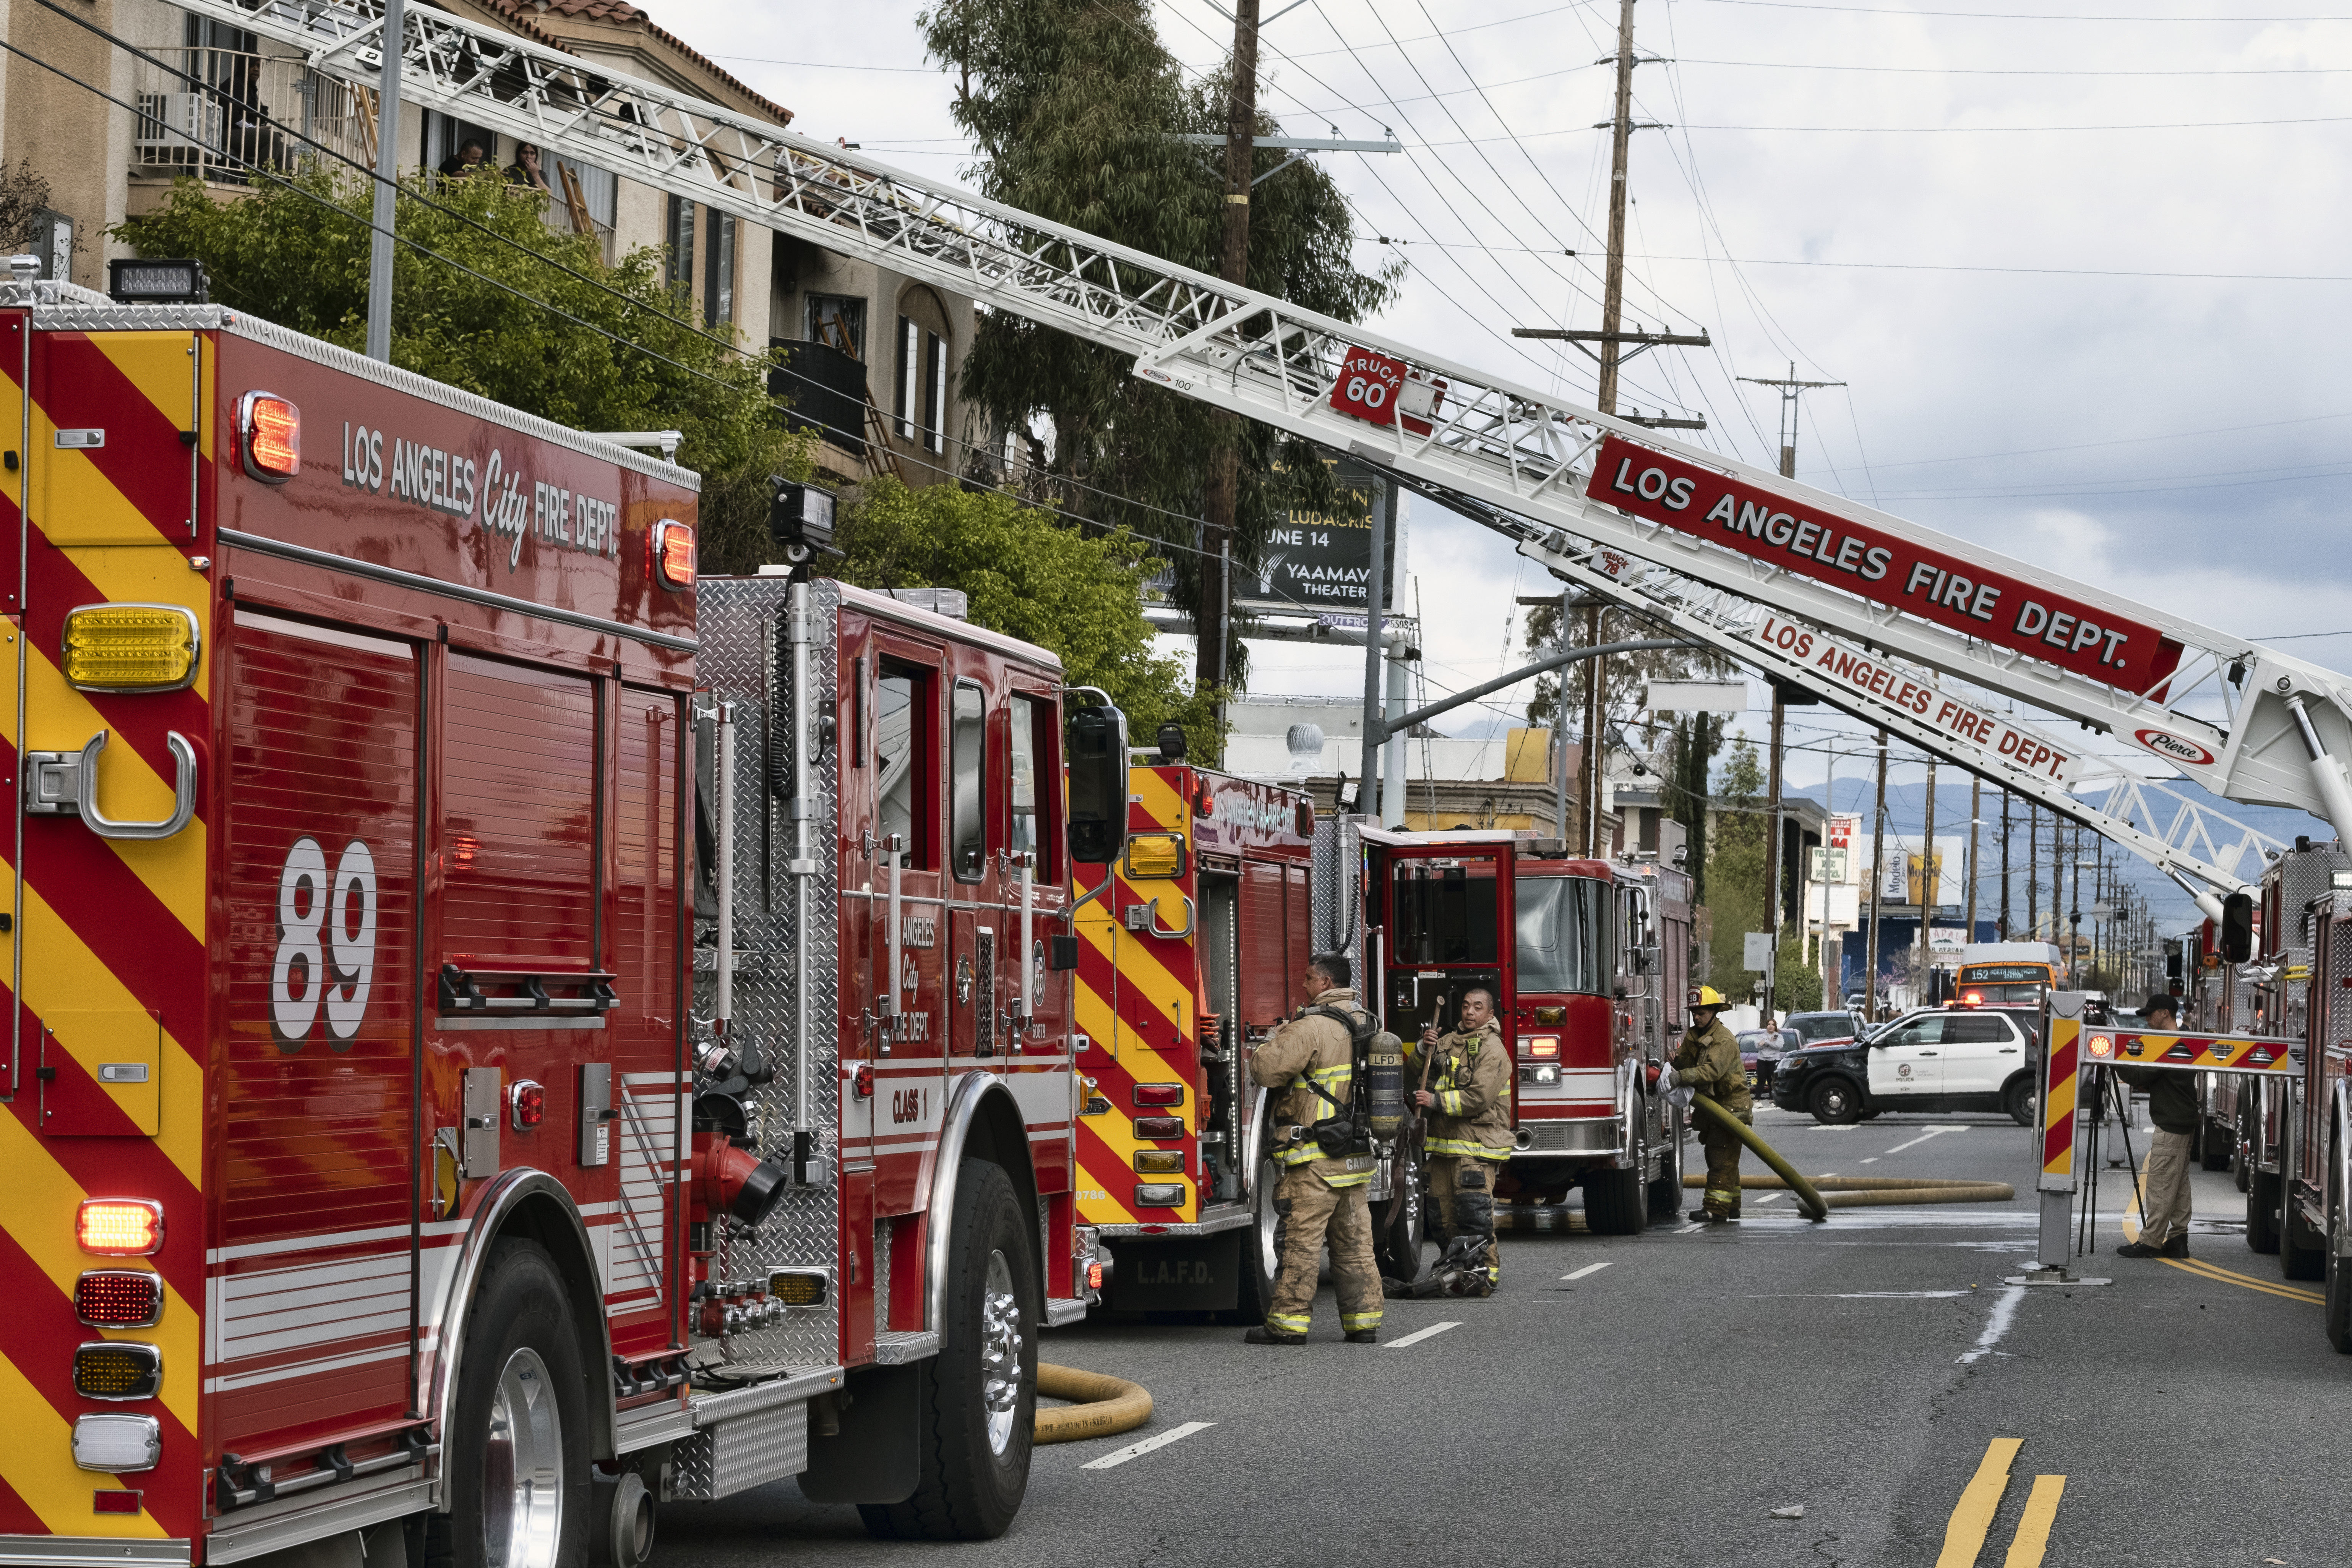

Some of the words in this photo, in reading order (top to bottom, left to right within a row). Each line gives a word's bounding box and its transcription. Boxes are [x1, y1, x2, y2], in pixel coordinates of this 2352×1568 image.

[1148, 370, 1165, 379] Pierce
[1175, 379, 1194, 391] 100'
[1345, 358, 1400, 389] TRUCK
[1345, 376, 1386, 408] 60
[344, 421, 383, 491] LOS
[390, 437, 475, 516] ANGELES
[482, 449, 528, 567] City
[534, 481, 569, 543] FIRE
[576, 493, 617, 555] DEPT.
[1265, 529, 1303, 546] UNE
[1310, 532, 1330, 547] 14
[1286, 563, 1371, 583] YAAMAV
[1601, 551, 1630, 569] TRUCK
[1603, 559, 1620, 575] 78
[1611, 457, 1696, 510] LOS
[1702, 493, 1893, 582] ANGELES
[1903, 561, 2001, 622] FIRE
[2012, 600, 2128, 669] DEPT.
[1303, 582, 1367, 598] THEATER
[1761, 617, 1814, 658] LOS
[1816, 646, 1932, 714] ANGELES
[1935, 700, 1996, 745] FIRE
[1997, 730, 2068, 781] DEPT.
[2150, 734, 2196, 758] Pierce
[1227, 795, 1255, 828] ANGELES
[1268, 803, 1281, 832] FIRE
[1888, 856, 1901, 893] Modelo
[268, 835, 377, 1053] 89
[902, 916, 934, 948] ANGELES
[903, 953, 919, 1005] City
[1689, 994, 1697, 1002] 98
[910, 1012, 929, 1041] DEPT.
[1032, 1023, 1046, 1039] 60879
[1374, 1055, 1395, 1065] LFD
[893, 1088, 918, 1124] CLASS
[923, 1087, 927, 1120] 1
[1137, 1261, 1213, 1283] L.A.F.D.
